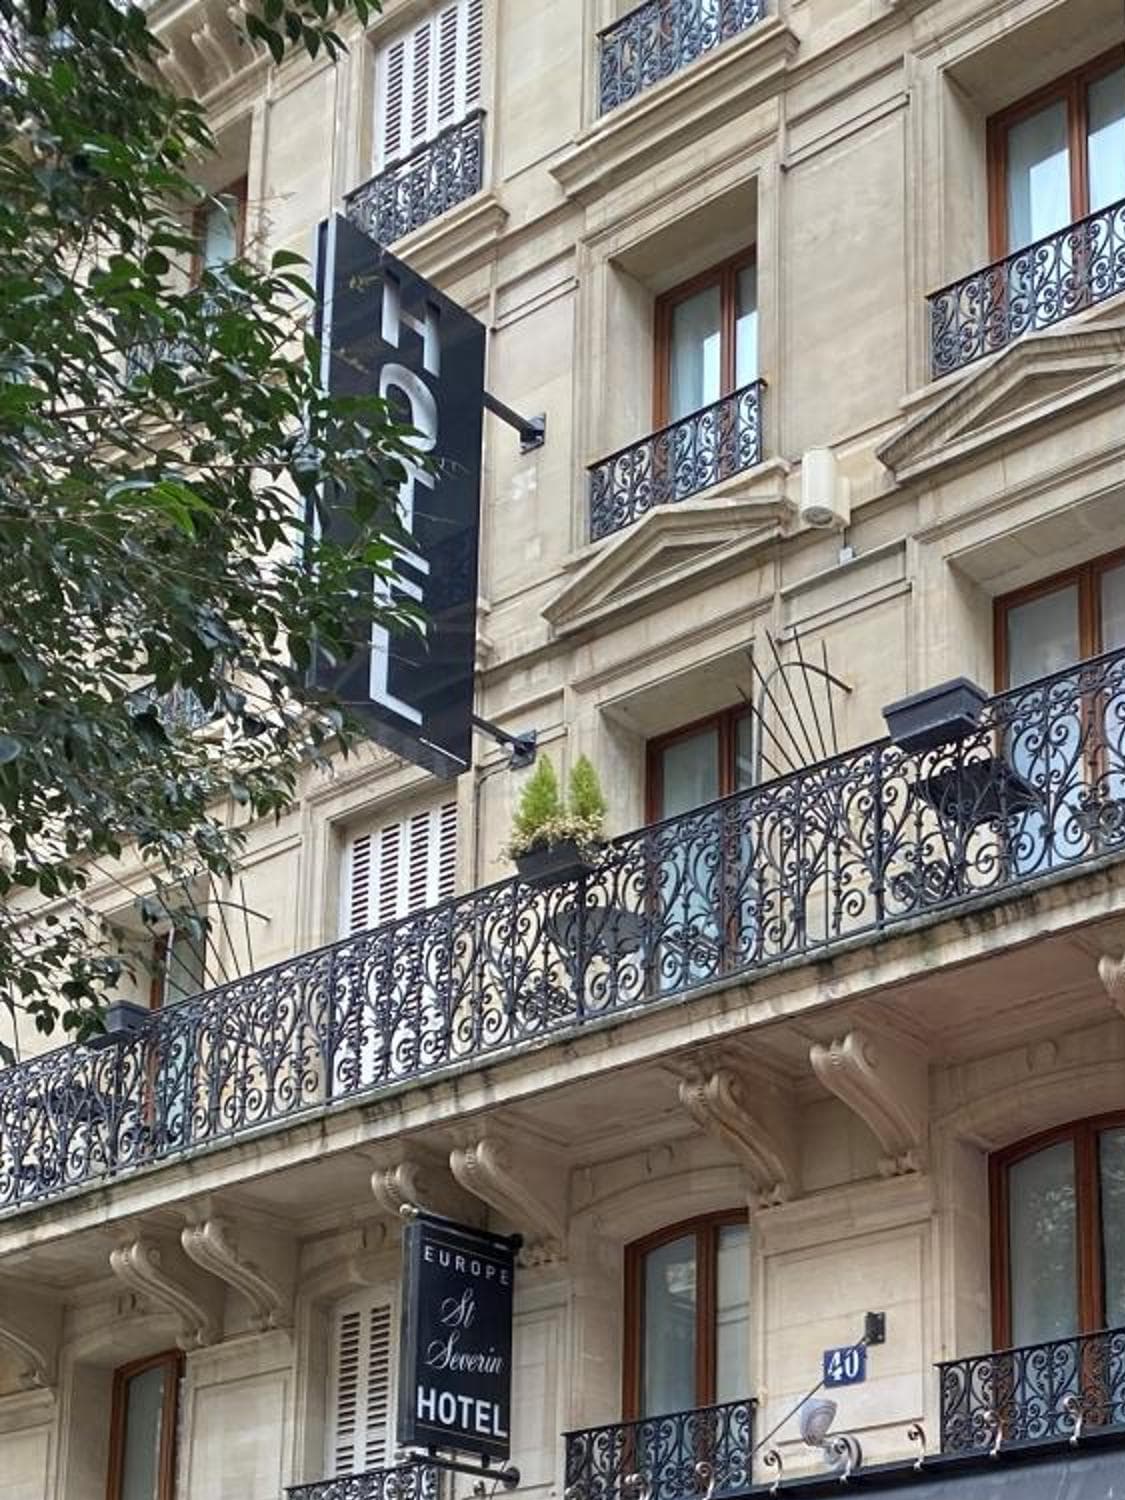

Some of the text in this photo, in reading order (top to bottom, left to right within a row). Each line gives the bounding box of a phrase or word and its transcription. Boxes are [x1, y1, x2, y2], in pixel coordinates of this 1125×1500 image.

[424, 1245, 509, 1285] EUROPE
[441, 1288, 475, 1328] St
[427, 1330, 502, 1374] Severin
[827, 1349, 859, 1381] 40
[417, 1385, 508, 1438] HOTEL
